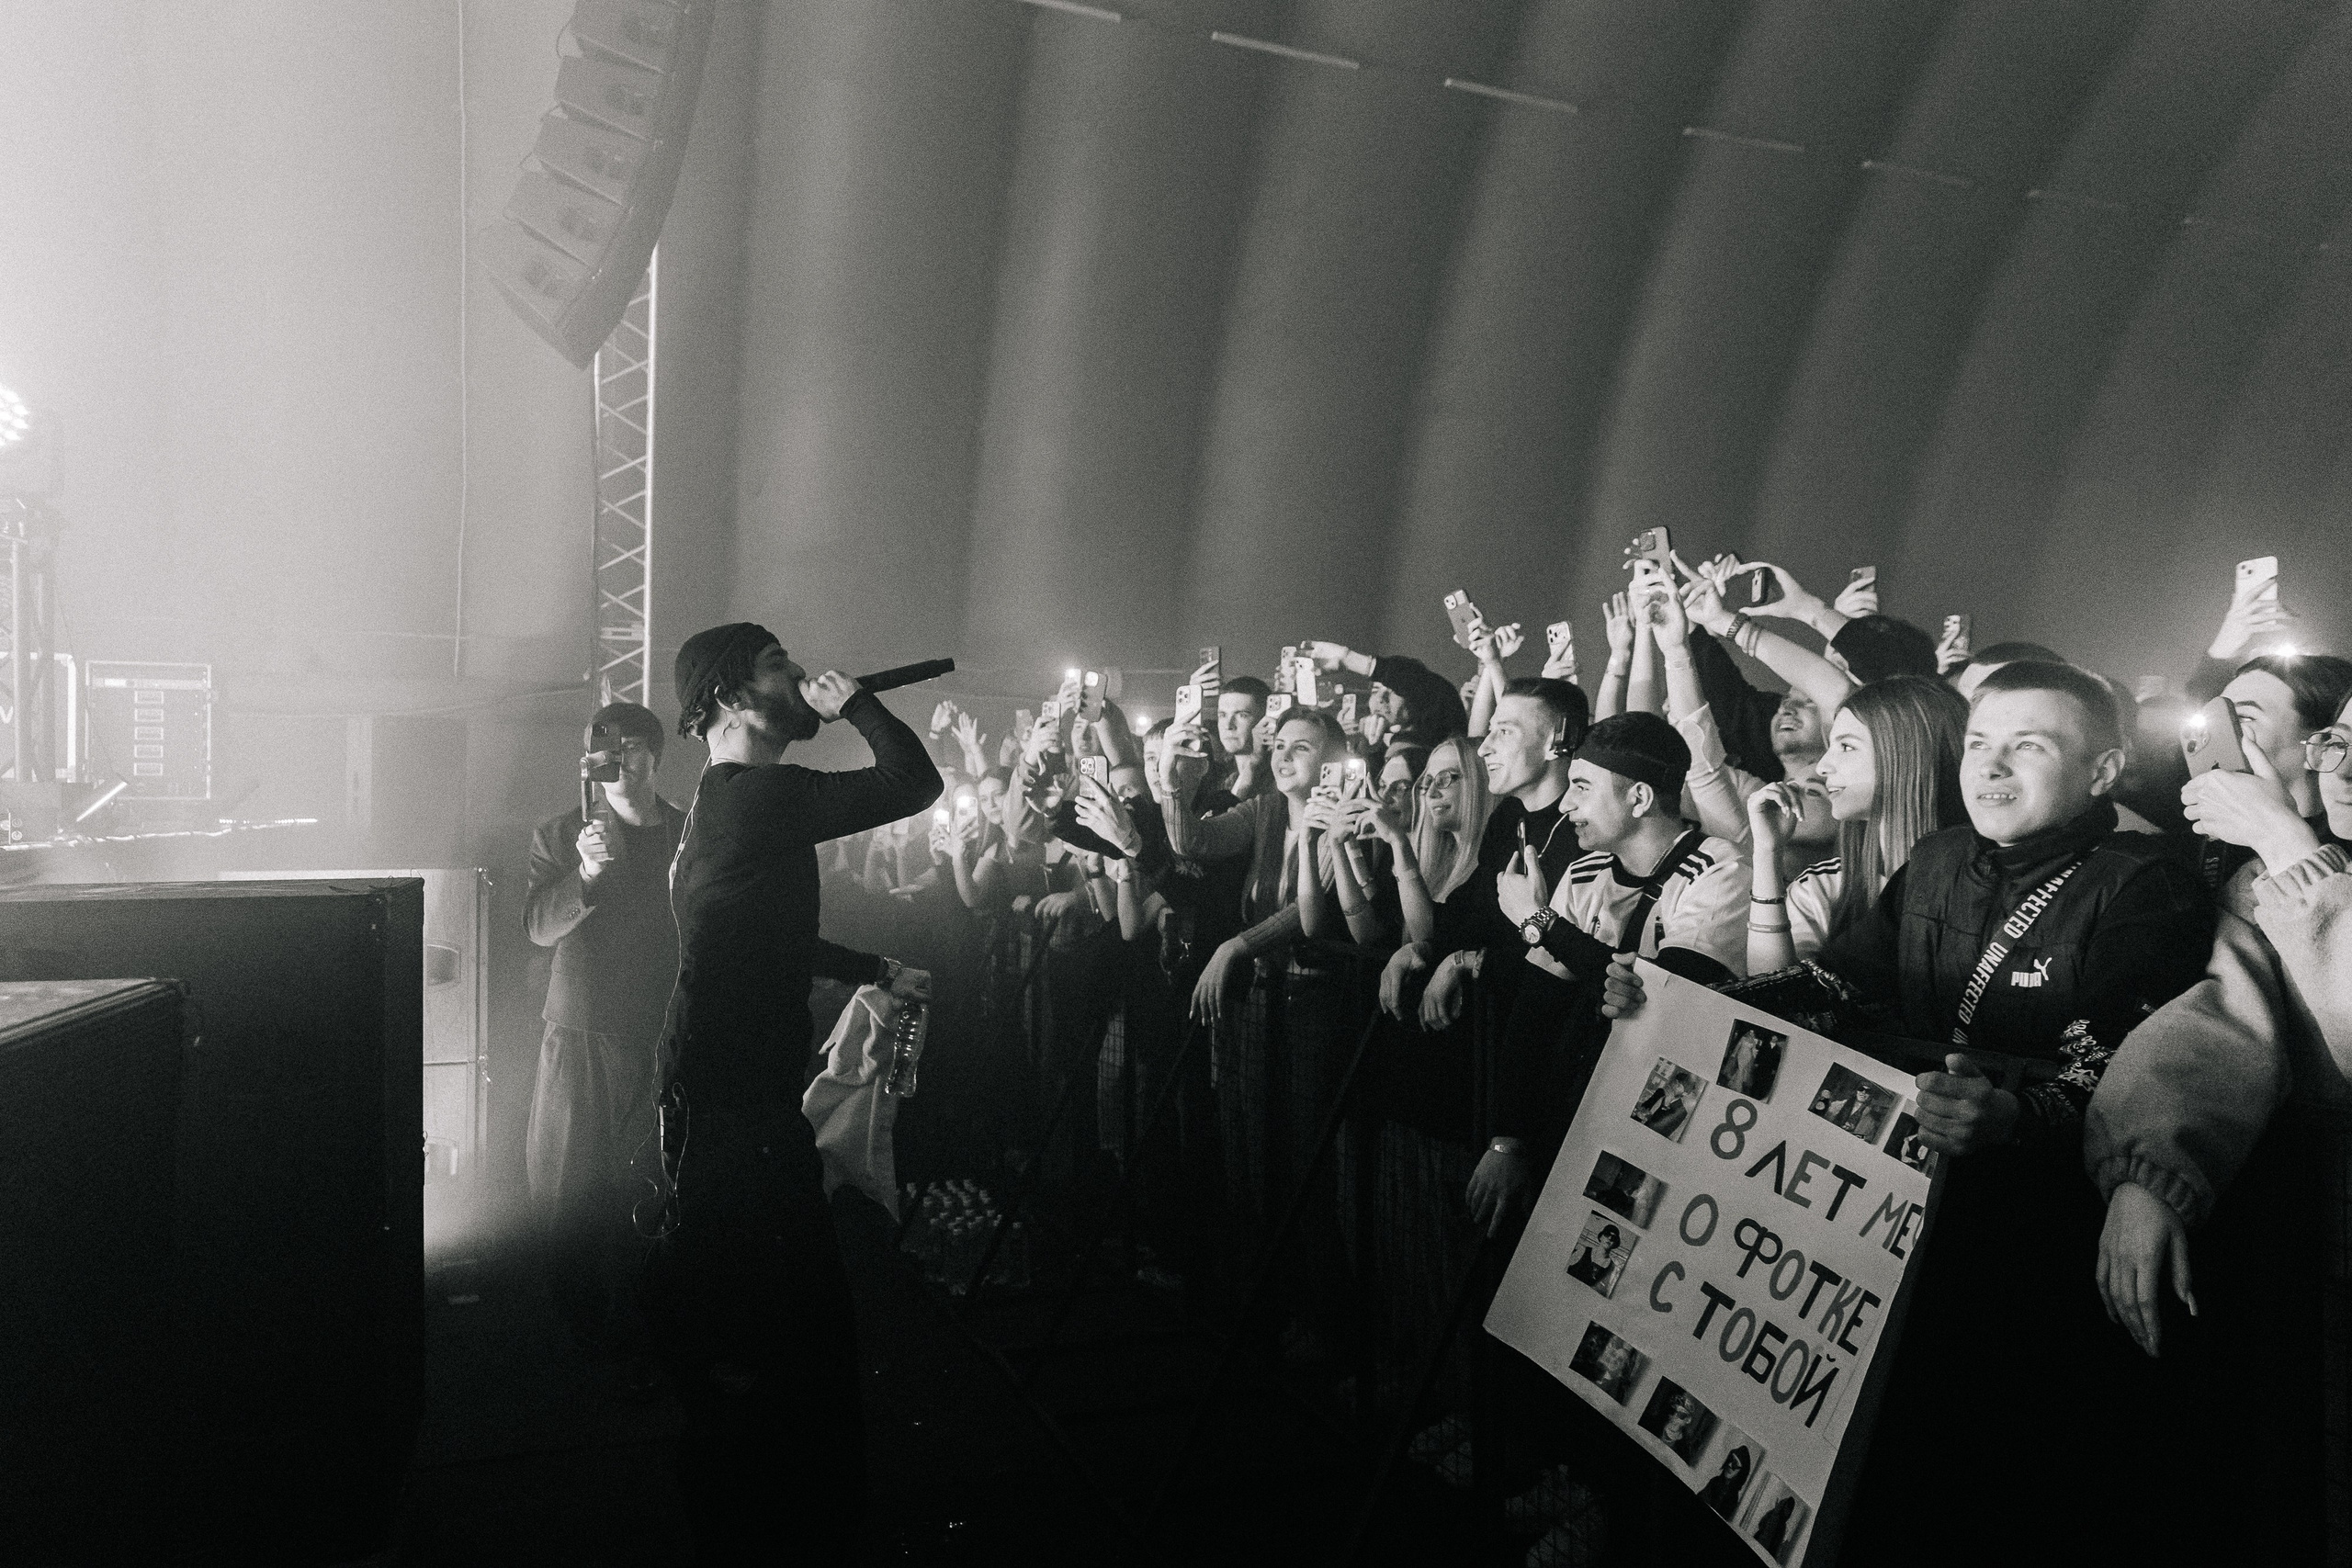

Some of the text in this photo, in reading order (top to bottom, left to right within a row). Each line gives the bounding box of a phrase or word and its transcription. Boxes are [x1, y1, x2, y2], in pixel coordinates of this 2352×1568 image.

[2003, 861, 2083, 939] AFFECTED
[1958, 942, 2008, 1025] UNAFFECTED
[2010, 971, 2042, 988] PUMA
[1710, 1098, 1758, 1160] 8
[1744, 1139, 1867, 1222] ЛЕТ
[1679, 1193, 1882, 1356] О ФОТКЕ
[1649, 1260, 1839, 1428] С ТОБОЙ
